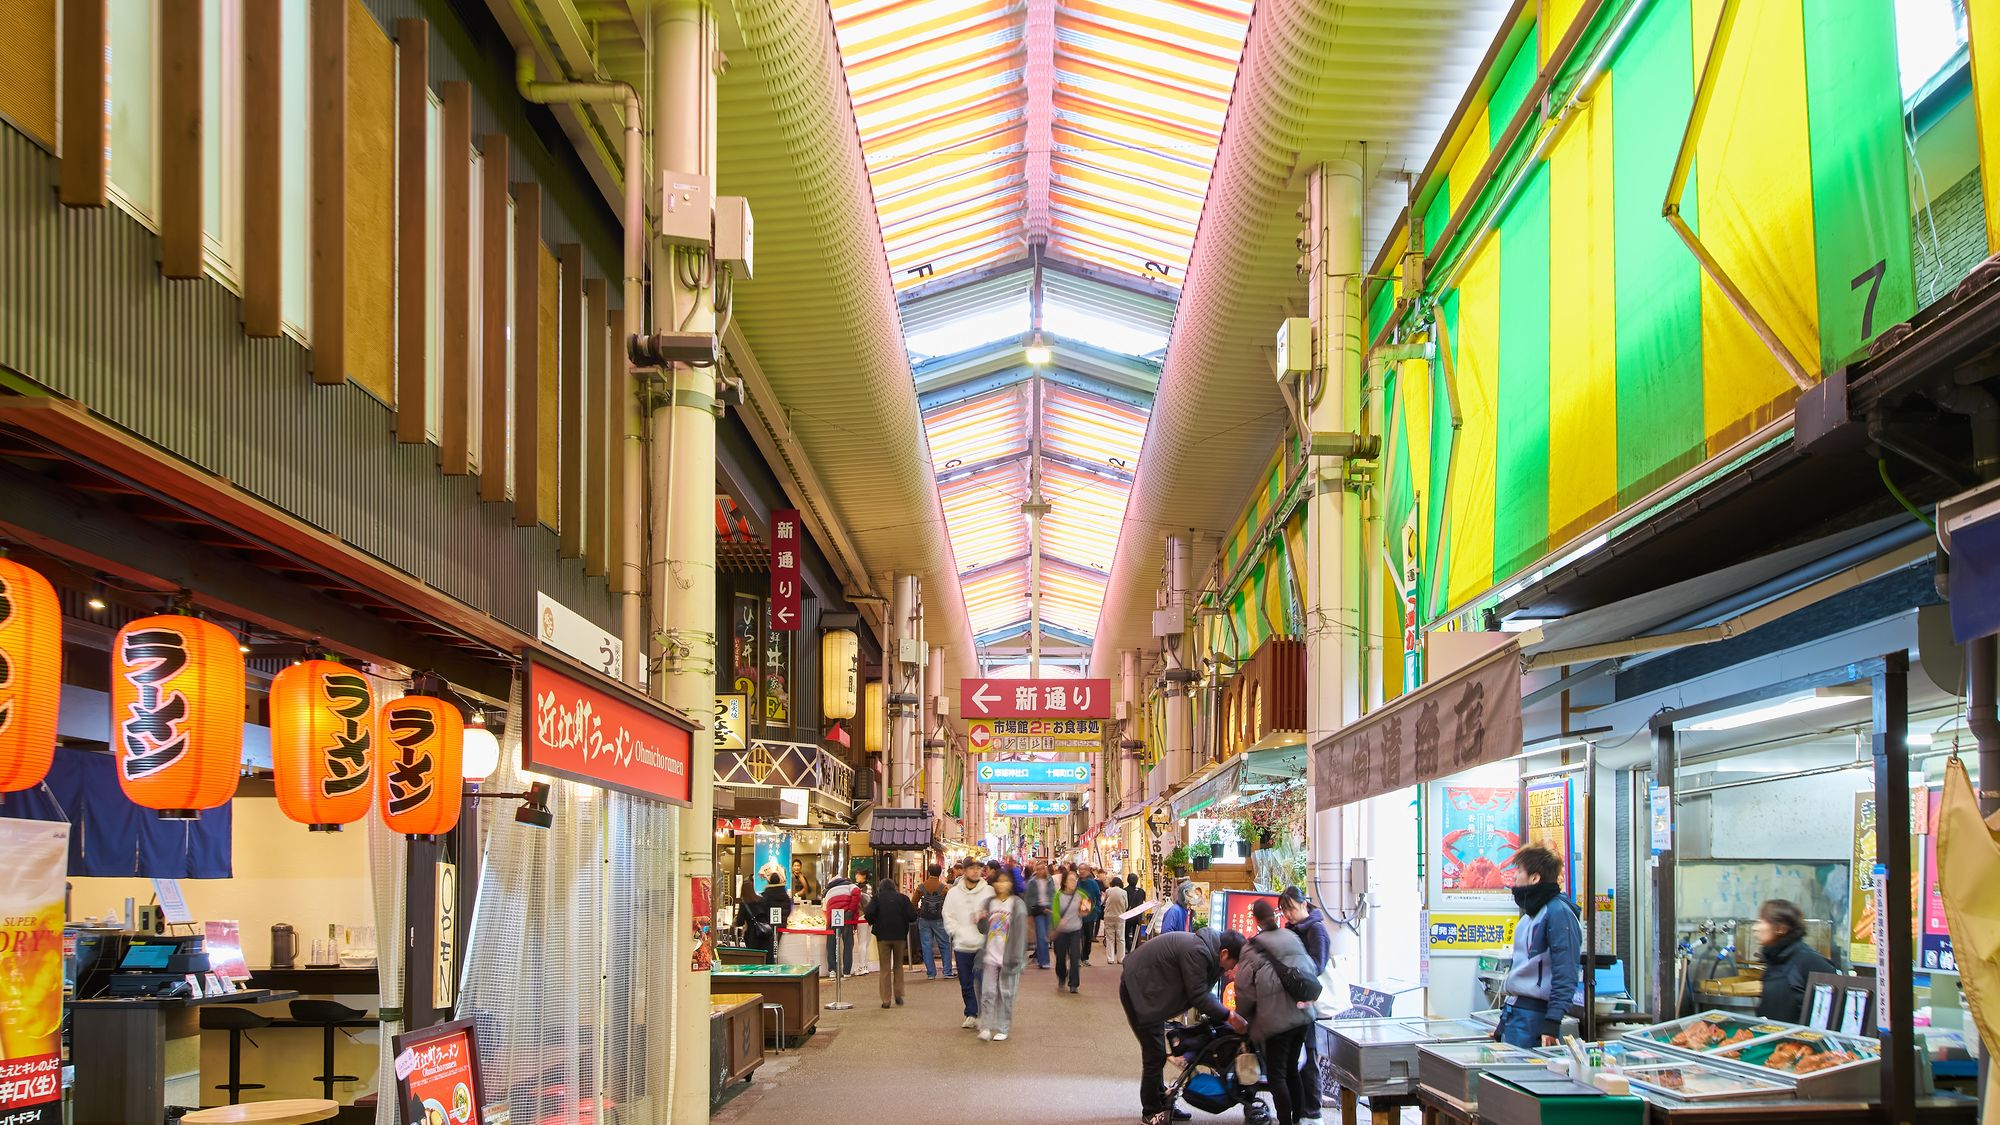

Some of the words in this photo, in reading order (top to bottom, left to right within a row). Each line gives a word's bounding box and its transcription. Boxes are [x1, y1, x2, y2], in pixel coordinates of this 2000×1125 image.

[1851, 259, 1886, 341] 7
[777, 521, 793, 598] 新通り
[122, 629, 190, 781] ラーメン
[1015, 686, 1091, 711] 新通り
[321, 672, 372, 798] ラーメン
[537, 690, 634, 768] 近江町ラーメン
[635, 740, 684, 776] Ohmichoramen
[993, 720, 1100, 734] 市場館2Fお食事処
[388, 707, 435, 816] ラーメン
[3, 916, 38, 927] SUPER
[439, 867, 454, 1002] OPEN
[772, 909, 779, 922] 出口
[834, 911, 841, 925] 入口
[1439, 926, 1456, 935] 発送
[1458, 924, 1504, 943] 全国発送承
